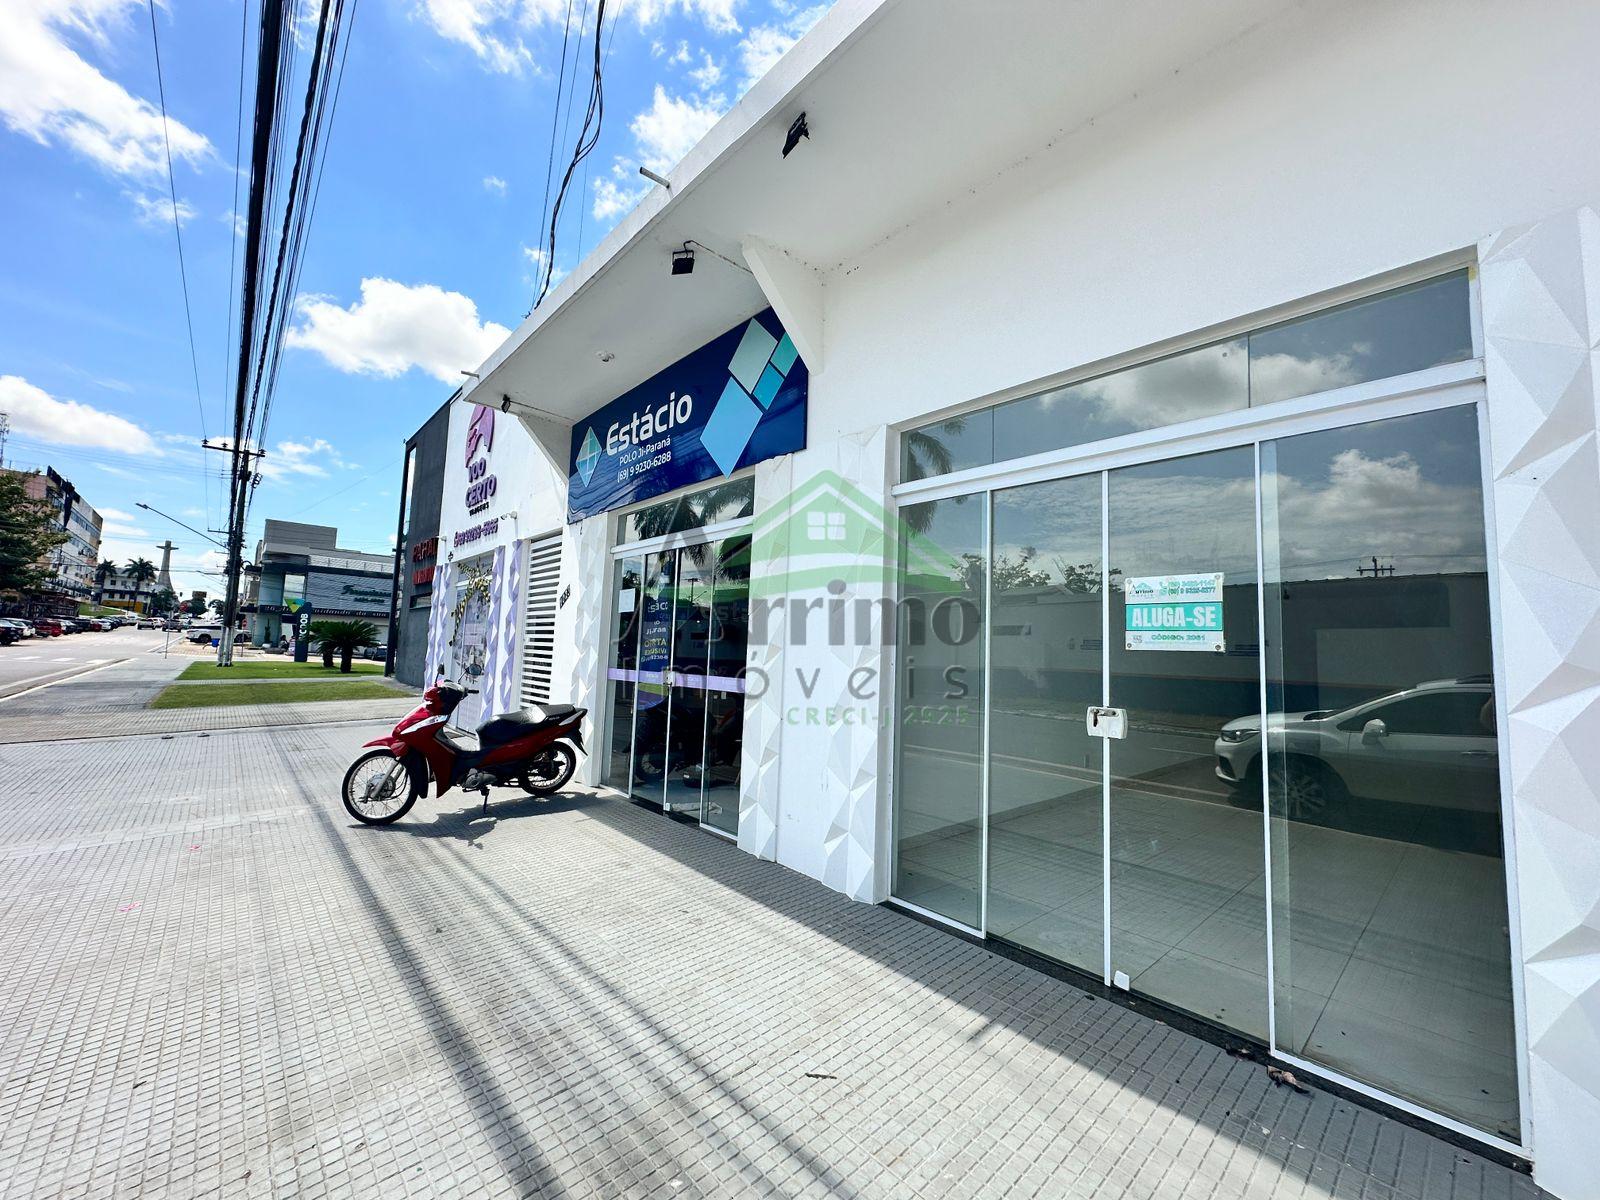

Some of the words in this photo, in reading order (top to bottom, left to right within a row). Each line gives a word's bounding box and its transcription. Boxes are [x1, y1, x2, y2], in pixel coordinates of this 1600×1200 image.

[606, 391, 693, 456] Estácio
[619, 450, 638, 465] POLO
[638, 437, 671, 460] Ji-Paraná
[617, 467, 630, 483] (69)
[630, 466, 636, 478] 9
[635, 453, 672, 474] 9230-6288
[465, 473, 497, 508] CERTO
[1132, 606, 1217, 627] ALUGA-SE
